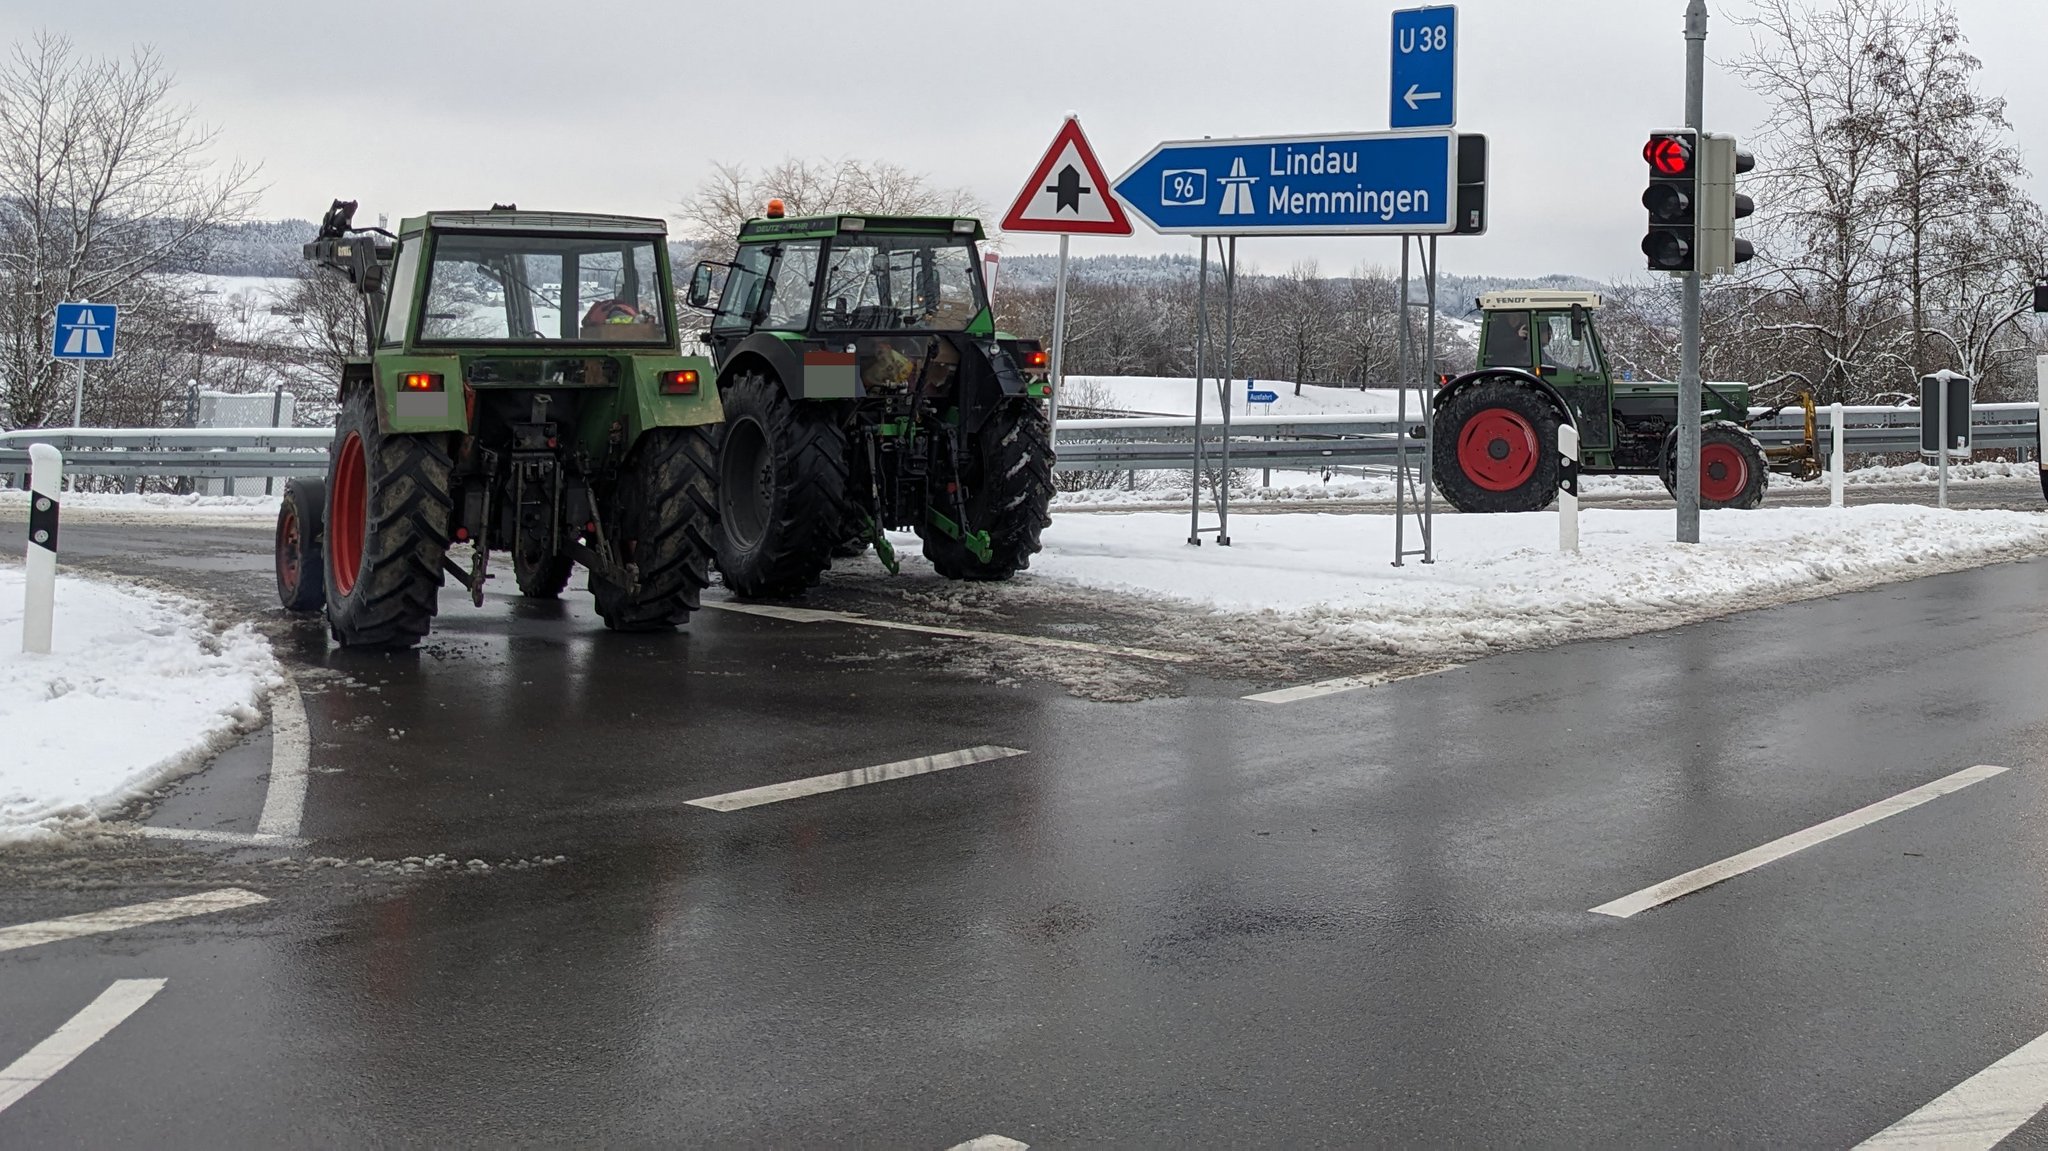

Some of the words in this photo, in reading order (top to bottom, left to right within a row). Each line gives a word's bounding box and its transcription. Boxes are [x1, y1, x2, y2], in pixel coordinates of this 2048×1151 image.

[1400, 28, 1415, 54] U
[1419, 26, 1447, 52] 38
[1270, 146, 1358, 176] Lindau
[1174, 176, 1194, 198] 96
[1269, 184, 1429, 221] Memmingen
